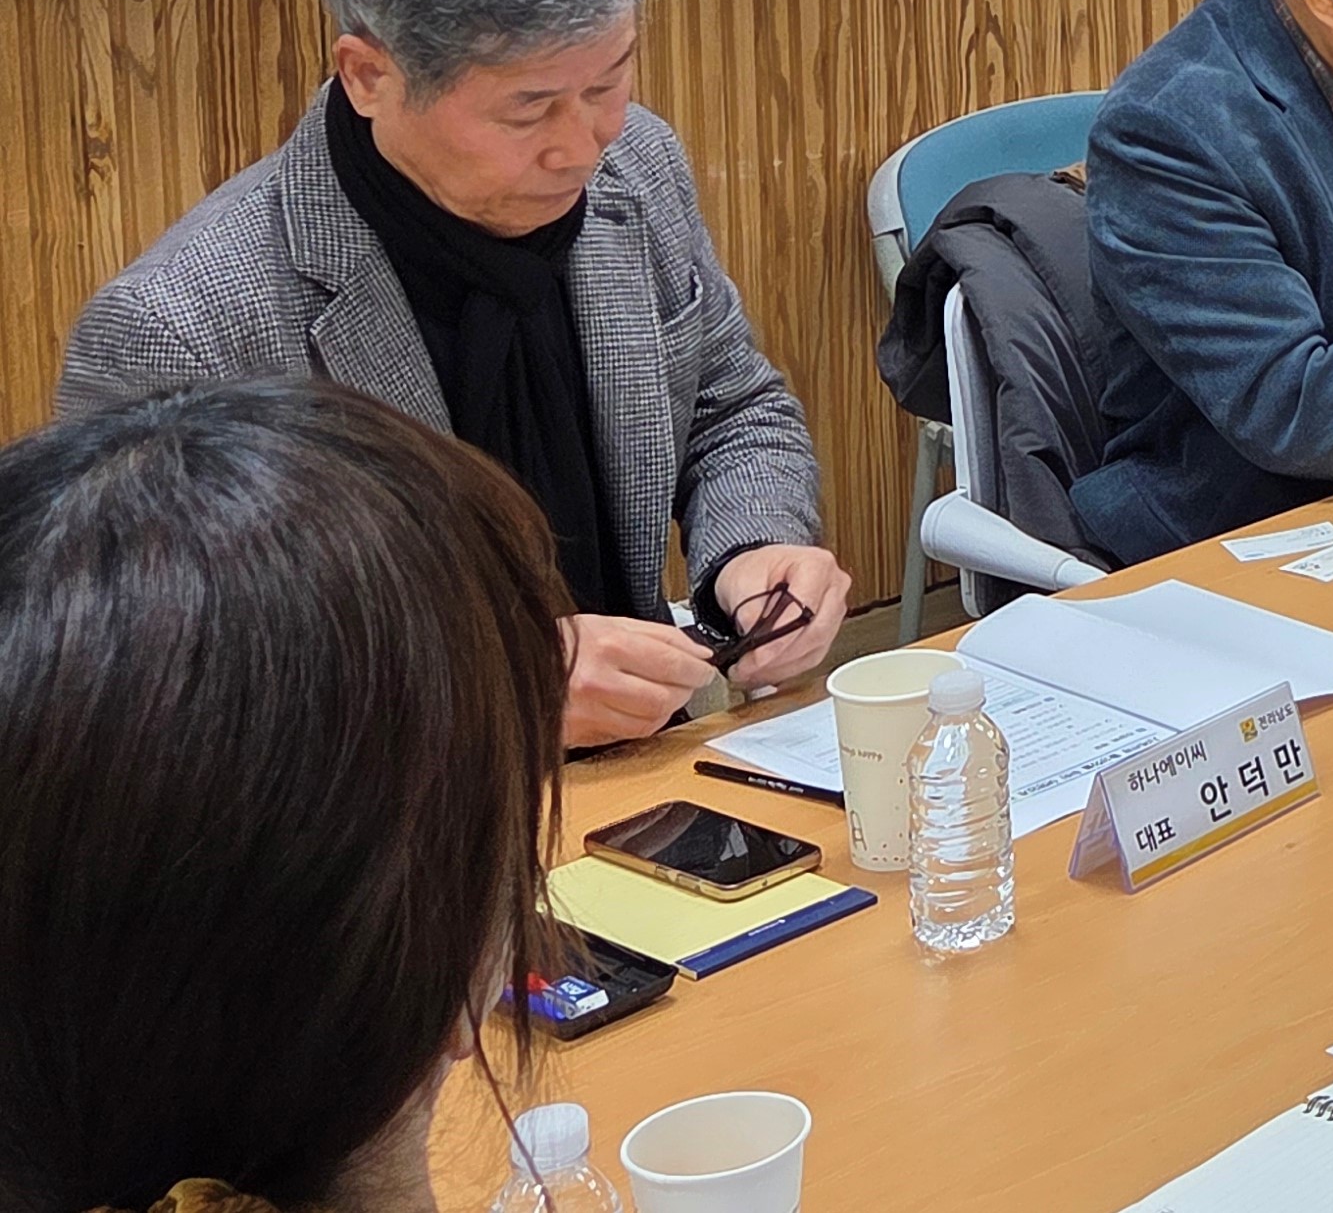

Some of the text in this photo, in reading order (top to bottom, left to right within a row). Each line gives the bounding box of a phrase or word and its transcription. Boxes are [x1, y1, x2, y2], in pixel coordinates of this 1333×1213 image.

[1257, 703, 1294, 731] 전라남도
[1127, 740, 1207, 792] 하나에이씨
[1135, 818, 1176, 852] 대표
[1200, 739, 1305, 823] 안덕만
